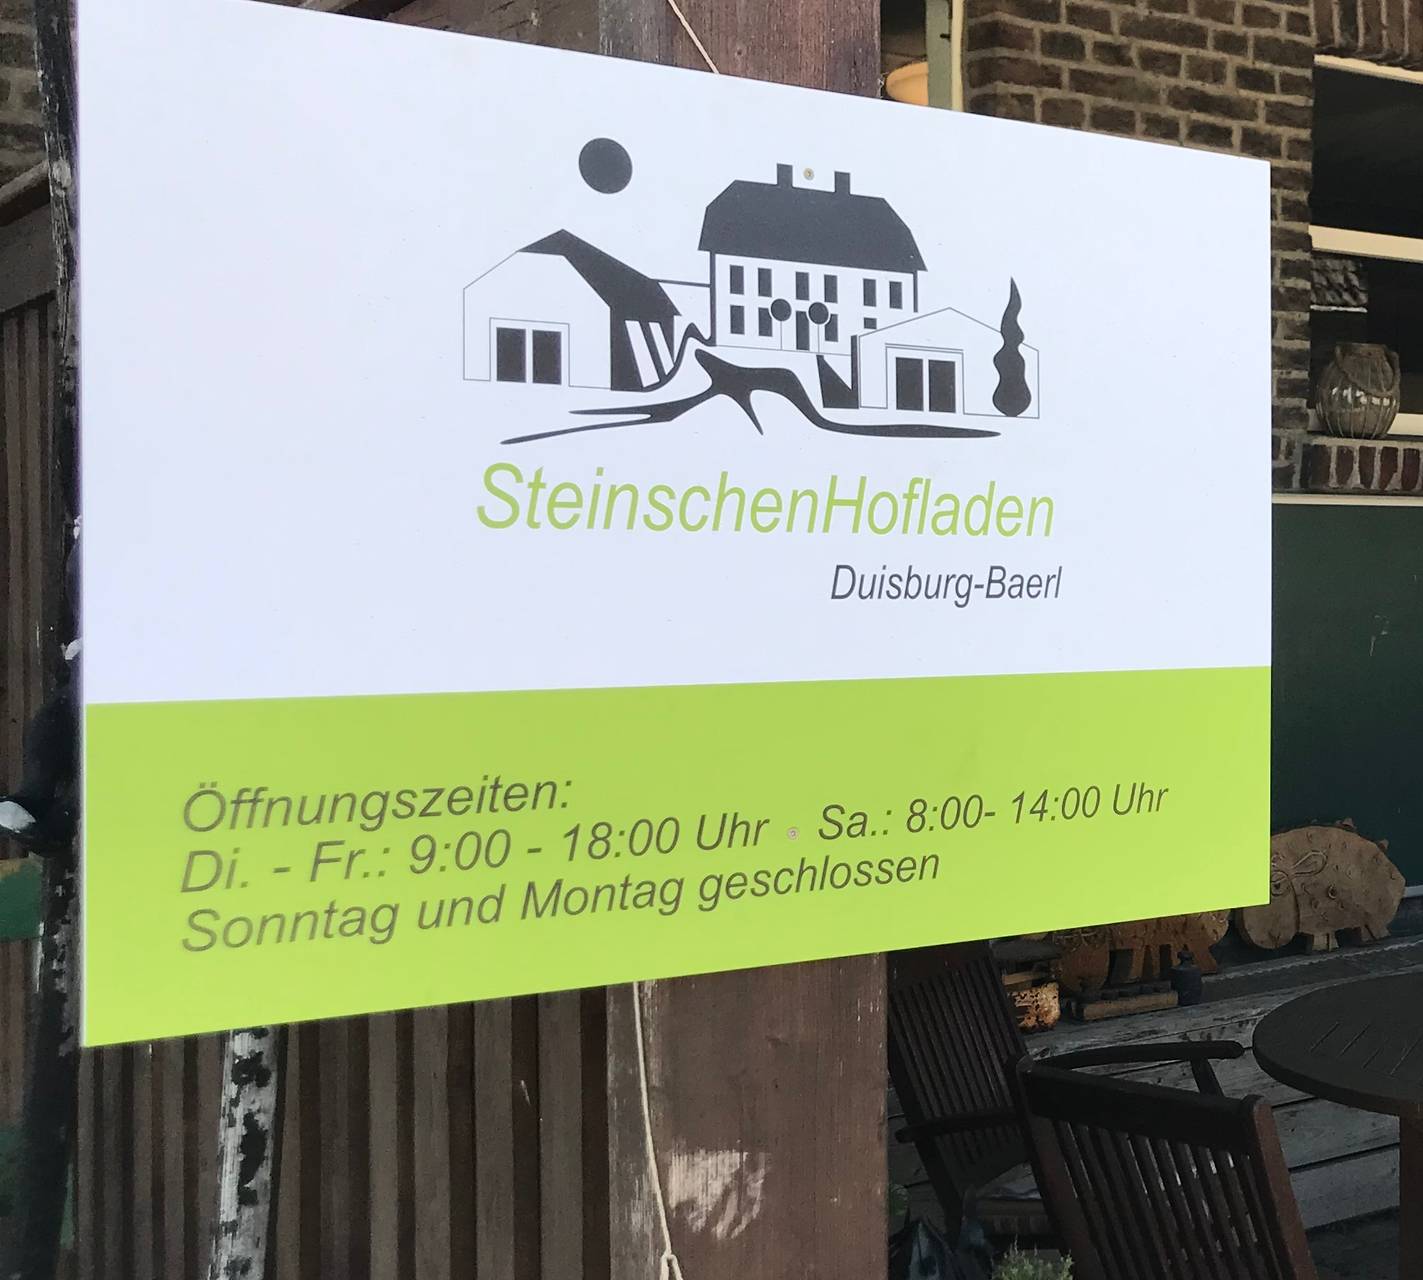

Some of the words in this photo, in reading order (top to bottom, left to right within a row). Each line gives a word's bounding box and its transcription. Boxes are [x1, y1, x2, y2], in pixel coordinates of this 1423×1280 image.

[476, 462, 1055, 538] SteinschenHofladen
[830, 564, 1063, 609] Duisburg-Baerl
[180, 846, 249, 893] Di.
[309, 839, 391, 882] Fr.:
[409, 828, 512, 875] 9:00
[562, 816, 682, 862] 18:00
[696, 811, 771, 851] Uhr
[817, 803, 893, 841] Sa.:
[1011, 784, 1102, 825] 14:00
[1112, 780, 1170, 817] Uhr
[182, 774, 573, 833] Öffnungszeiten:
[181, 900, 400, 952] Sonntag
[417, 883, 507, 930] und
[520, 873, 686, 918] Montag
[697, 853, 941, 913] geschlossen
